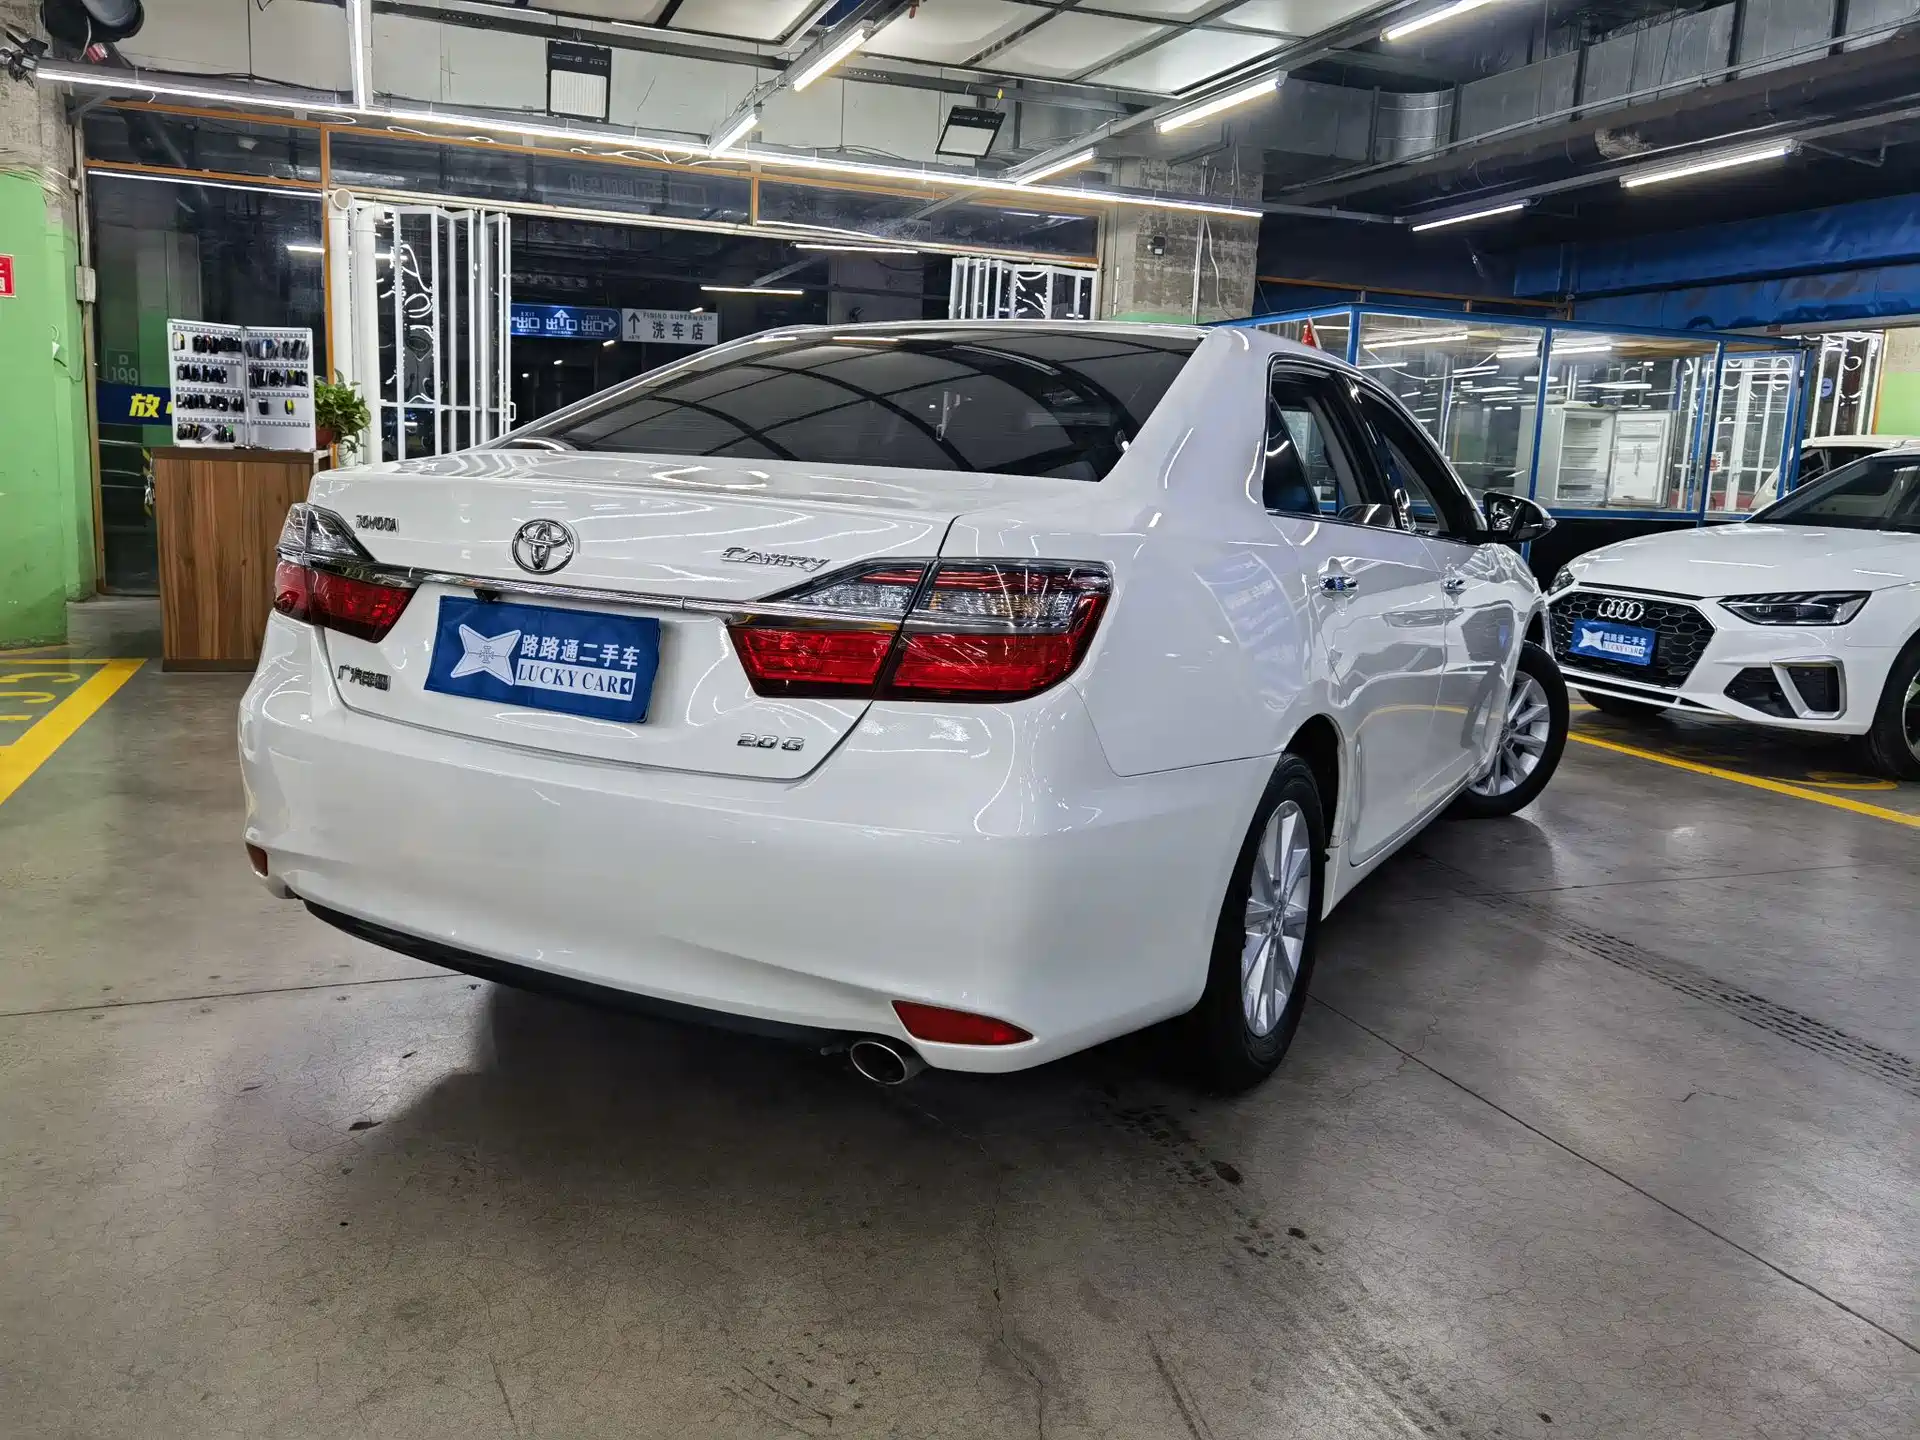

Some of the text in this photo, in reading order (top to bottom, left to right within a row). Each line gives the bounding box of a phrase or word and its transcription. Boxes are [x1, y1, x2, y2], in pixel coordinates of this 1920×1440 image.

[516, 317, 540, 329] 出口
[581, 319, 604, 332] 出口
[652, 321, 704, 341] 洗车店
[719, 547, 830, 573] CAMRY
[520, 634, 641, 670] 路路通二手车
[517, 663, 618, 694] LUCKY CAR
